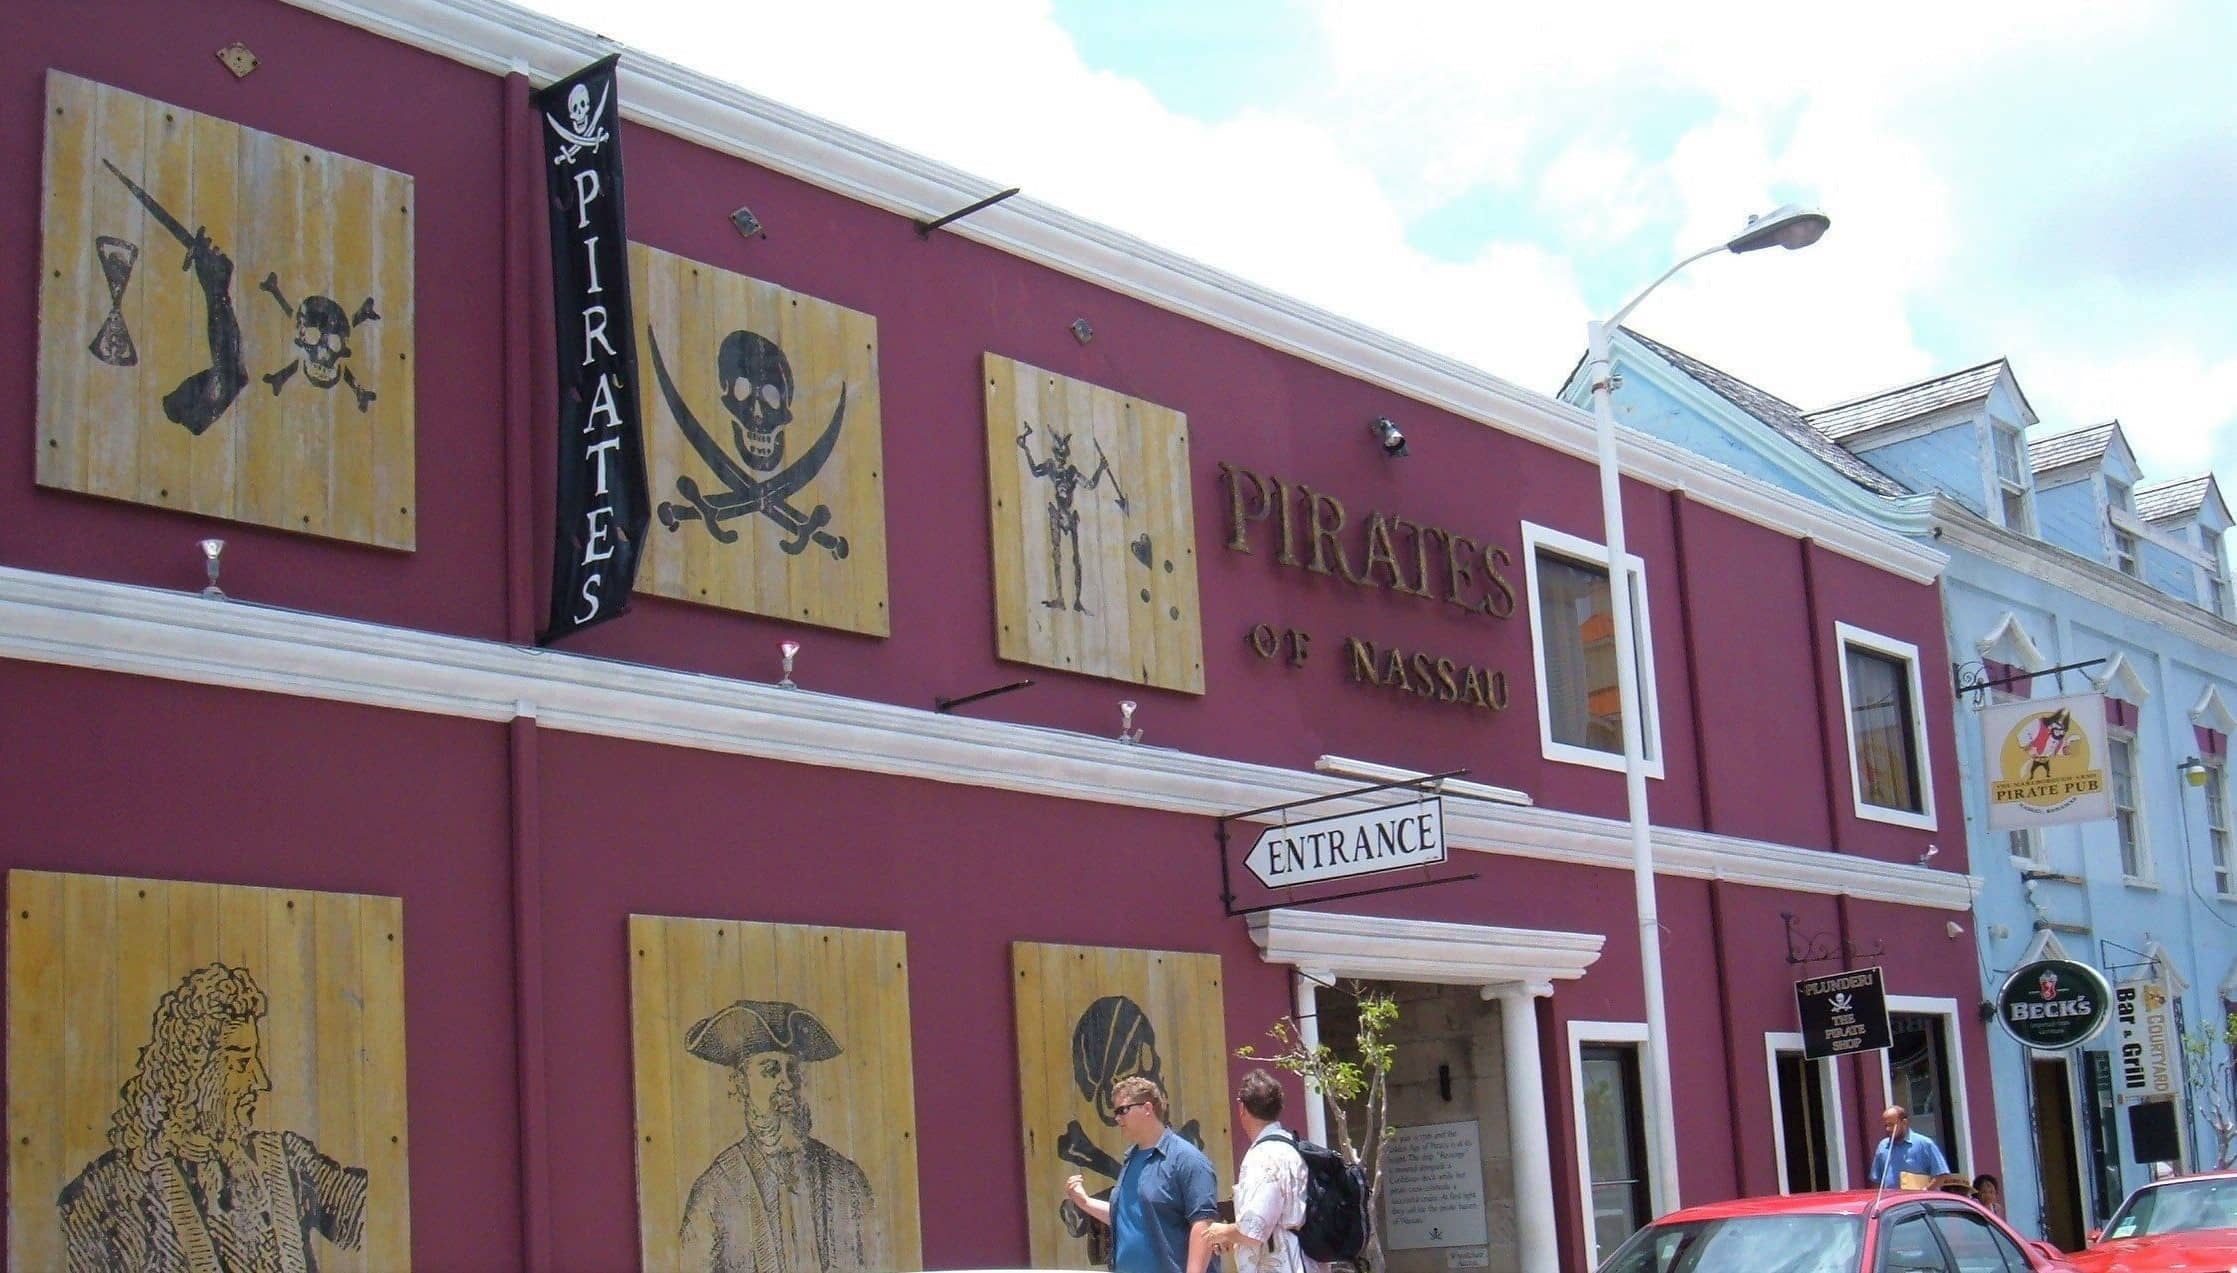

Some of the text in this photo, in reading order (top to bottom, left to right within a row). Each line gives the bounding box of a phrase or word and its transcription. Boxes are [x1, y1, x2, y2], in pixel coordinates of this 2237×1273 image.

[573, 169, 623, 625] PIRATES
[1217, 461, 1516, 620] PIRATES
[1248, 623, 1509, 710] OF NASSAU
[1996, 780, 2099, 801] PIRATE PUB
[1268, 814, 1436, 876] ENTRANCE
[1831, 1013, 1856, 1026] THE
[2010, 995, 2092, 1021] BECK'S
[2116, 988, 2136, 1025] Bar
[1824, 1024, 1867, 1039] PIRATE
[1831, 1038, 1862, 1051] SHOP
[2122, 1043, 2146, 1089] Grill
[2147, 1014, 2169, 1092] COURTYARD
